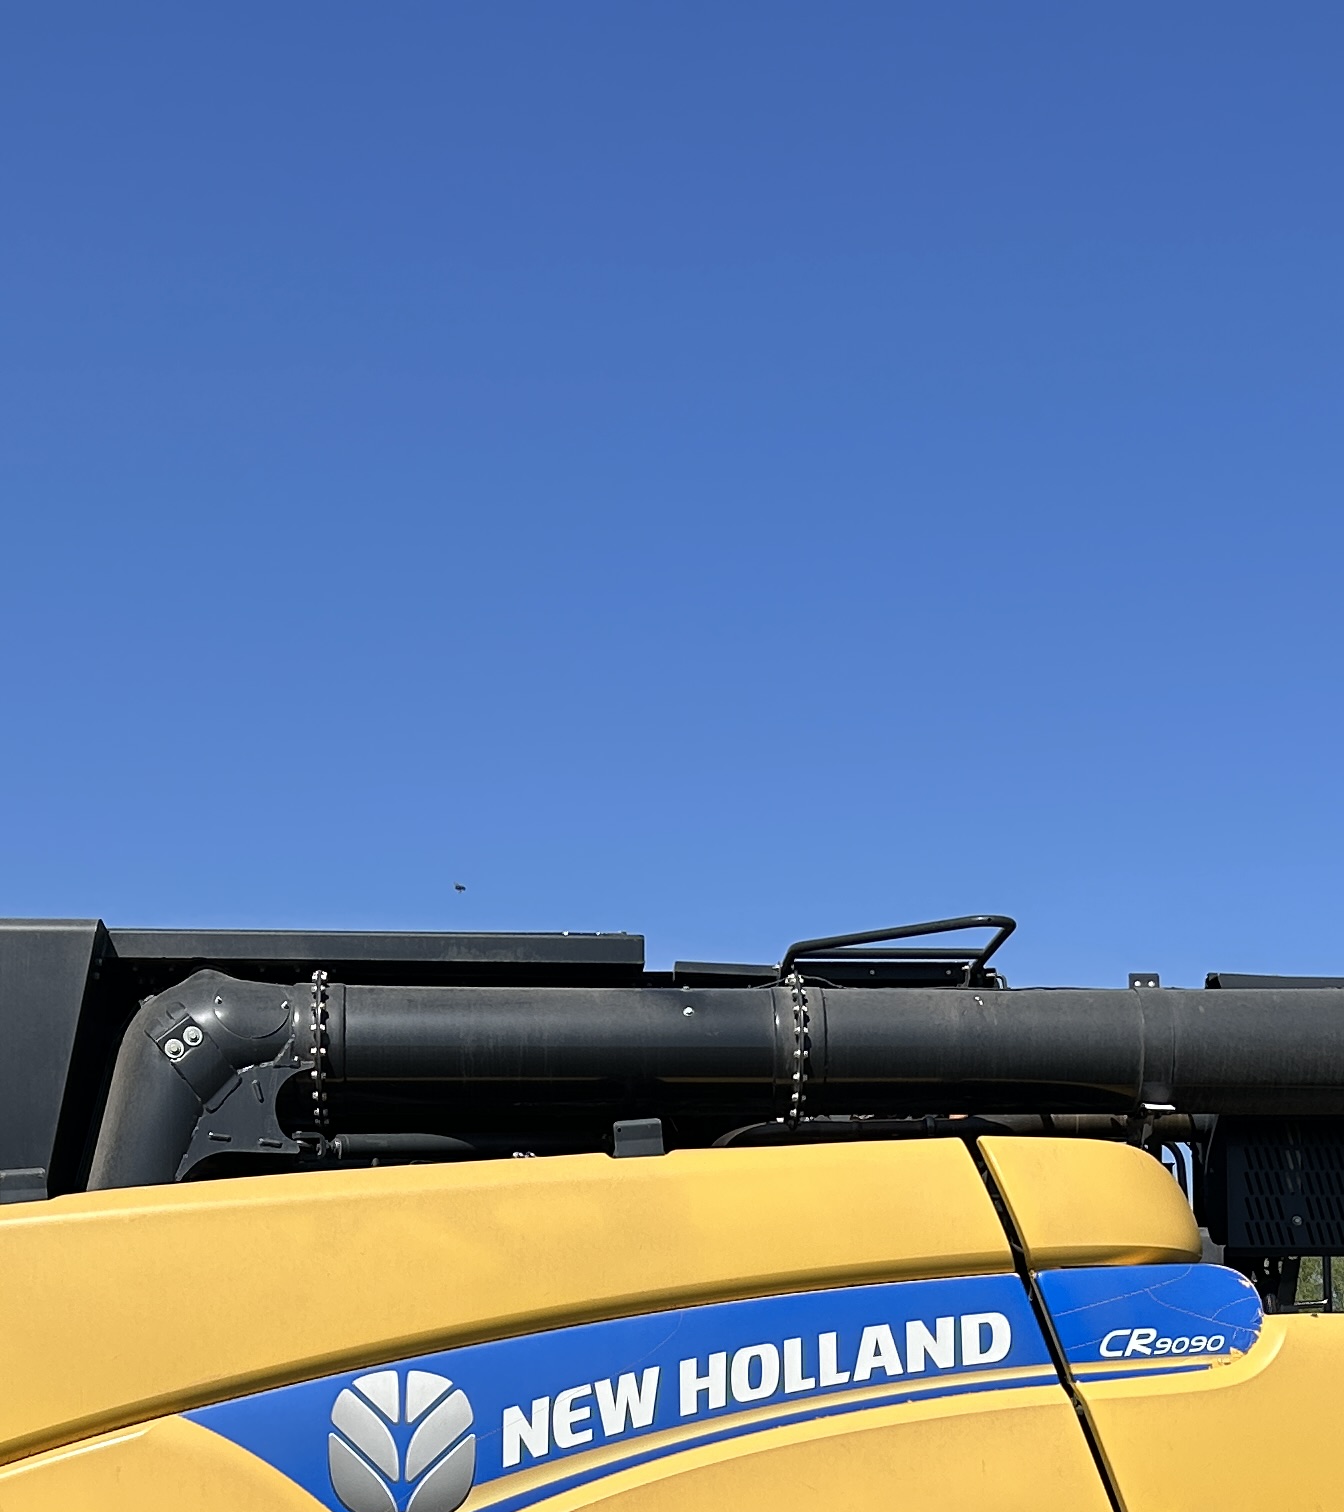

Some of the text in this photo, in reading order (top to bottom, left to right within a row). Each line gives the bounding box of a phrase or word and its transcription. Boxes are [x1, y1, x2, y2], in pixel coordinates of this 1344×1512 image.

[1099, 1327, 1225, 1358] CR9090
[502, 1311, 1012, 1469] NEW HOLLAND
